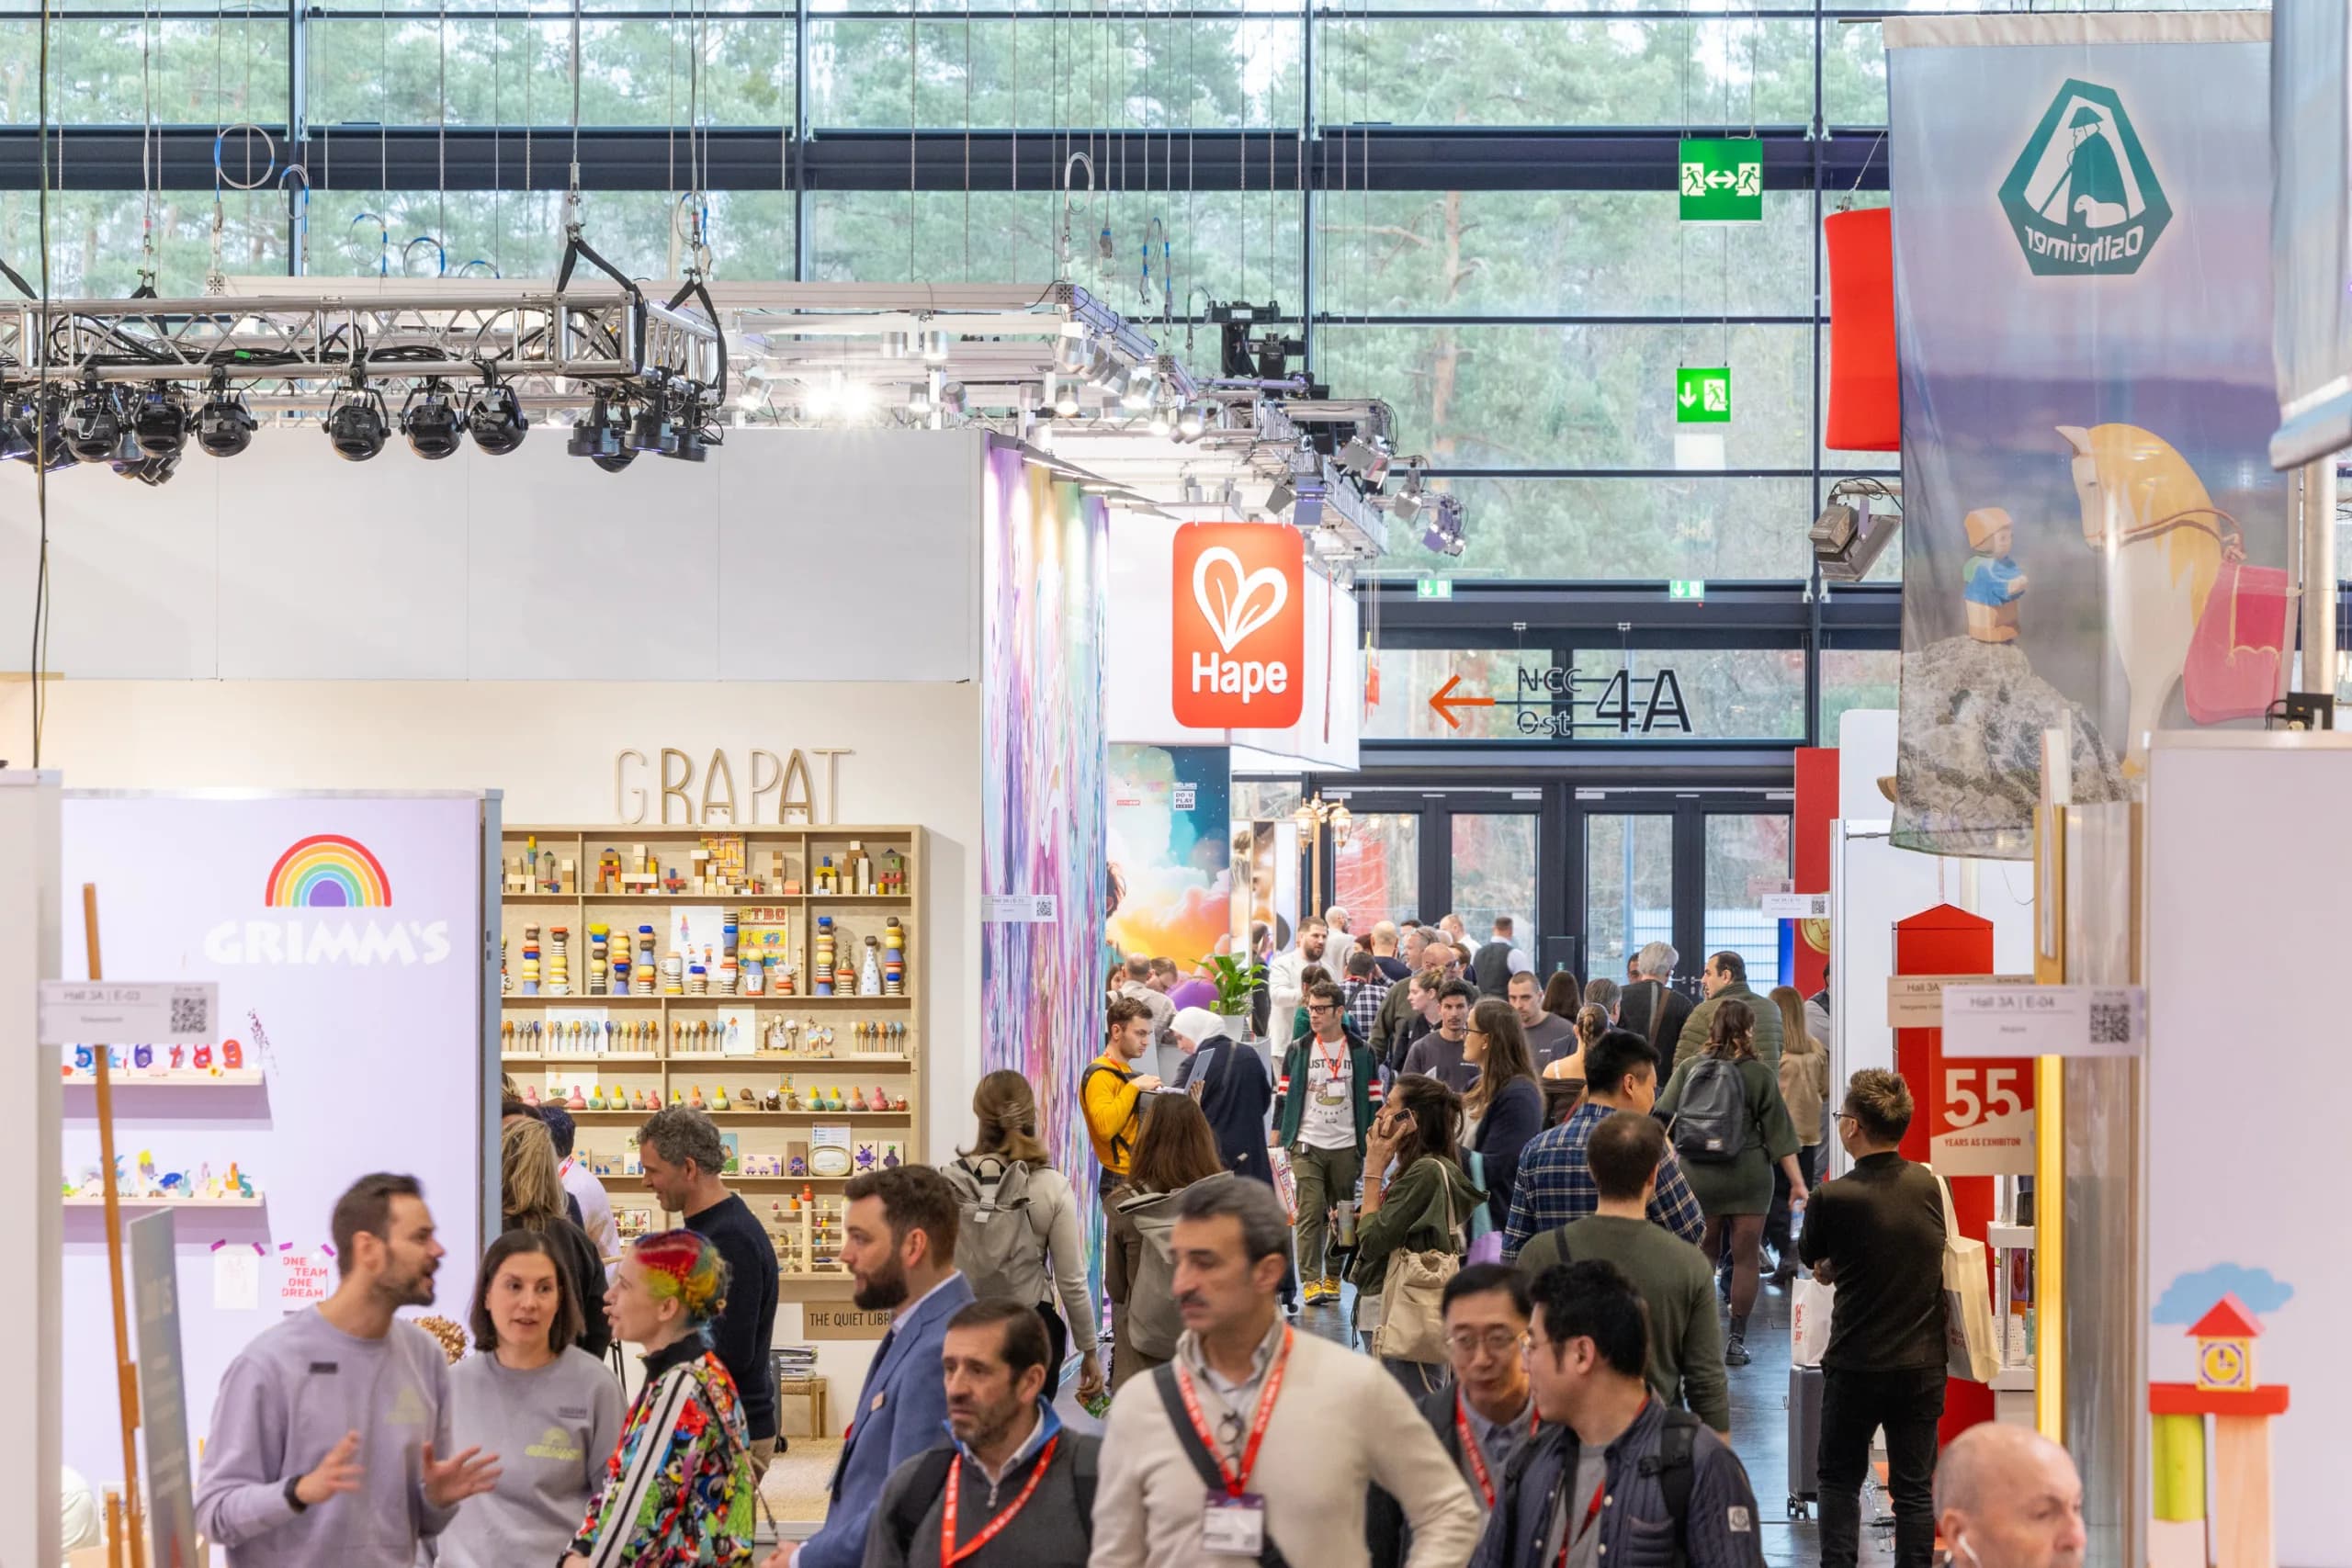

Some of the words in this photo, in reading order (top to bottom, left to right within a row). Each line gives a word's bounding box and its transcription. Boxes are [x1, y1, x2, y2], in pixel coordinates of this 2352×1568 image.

[1192, 652, 1287, 704] Hape
[1517, 666, 1582, 692] NCC
[1595, 669, 1694, 733] 4A
[1517, 710, 1571, 735] Ost
[615, 748, 854, 825] GRAPAT
[204, 919, 451, 966] GRIMM'S
[1907, 983, 1925, 992] Hall
[1927, 983, 1940, 992] 3A
[63, 989, 86, 1000] Hall
[1970, 996, 1994, 1008] Hall
[1996, 996, 2015, 1008] 3A
[2026, 996, 2055, 1008] E-04
[1308, 1058, 1326, 1068] UST
[1943, 1068, 2021, 1128] 55
[1945, 1138, 1969, 1147] YEARS
[1971, 1138, 1981, 1147] AS
[1982, 1138, 2021, 1147] EXHIBITOR
[282, 1257, 307, 1266] ONE
[294, 1268, 328, 1277] TEAM
[288, 1278, 312, 1287] ONE
[281, 1288, 323, 1298] DREAM
[809, 1314, 830, 1326] THE
[834, 1314, 864, 1327] QUIET
[868, 1313, 890, 1326] LIBR
